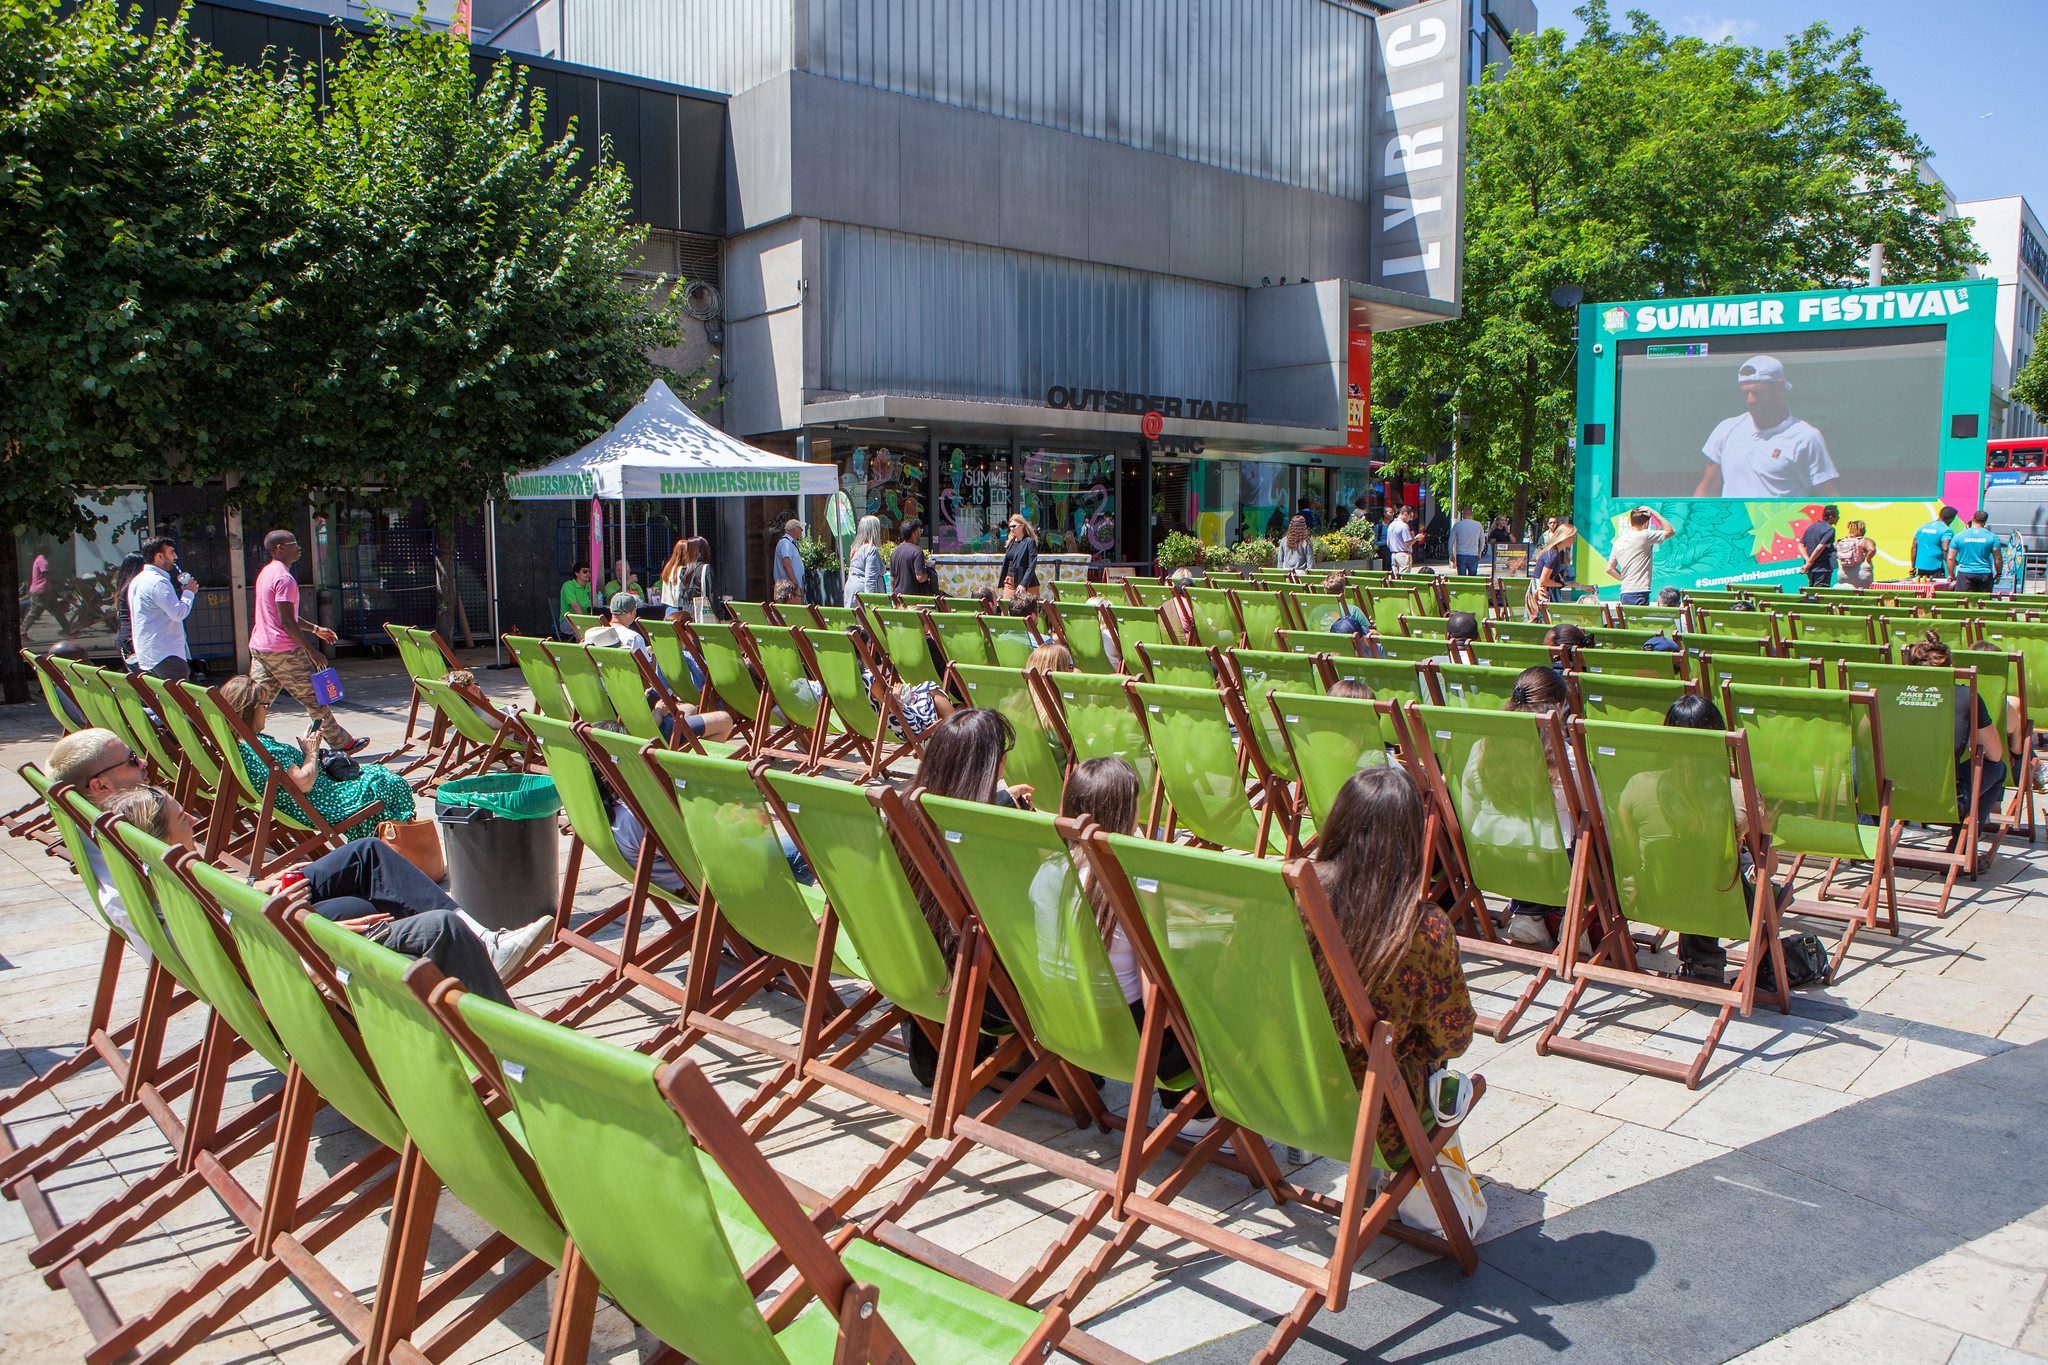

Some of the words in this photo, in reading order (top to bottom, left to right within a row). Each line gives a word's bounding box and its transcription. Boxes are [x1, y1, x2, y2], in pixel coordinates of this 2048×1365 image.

[1382, 17, 1447, 277] LYRIC
[1636, 300, 1784, 332] SUMMER
[1047, 386, 1182, 418] OUTSIDER
[1184, 399, 1249, 423] TART
[1141, 411, 1164, 440] @
[660, 472, 788, 494] HAMMERSMITH
[788, 470, 800, 491] BID
[972, 487, 984, 505] IS
[990, 487, 1012, 505] FOR
